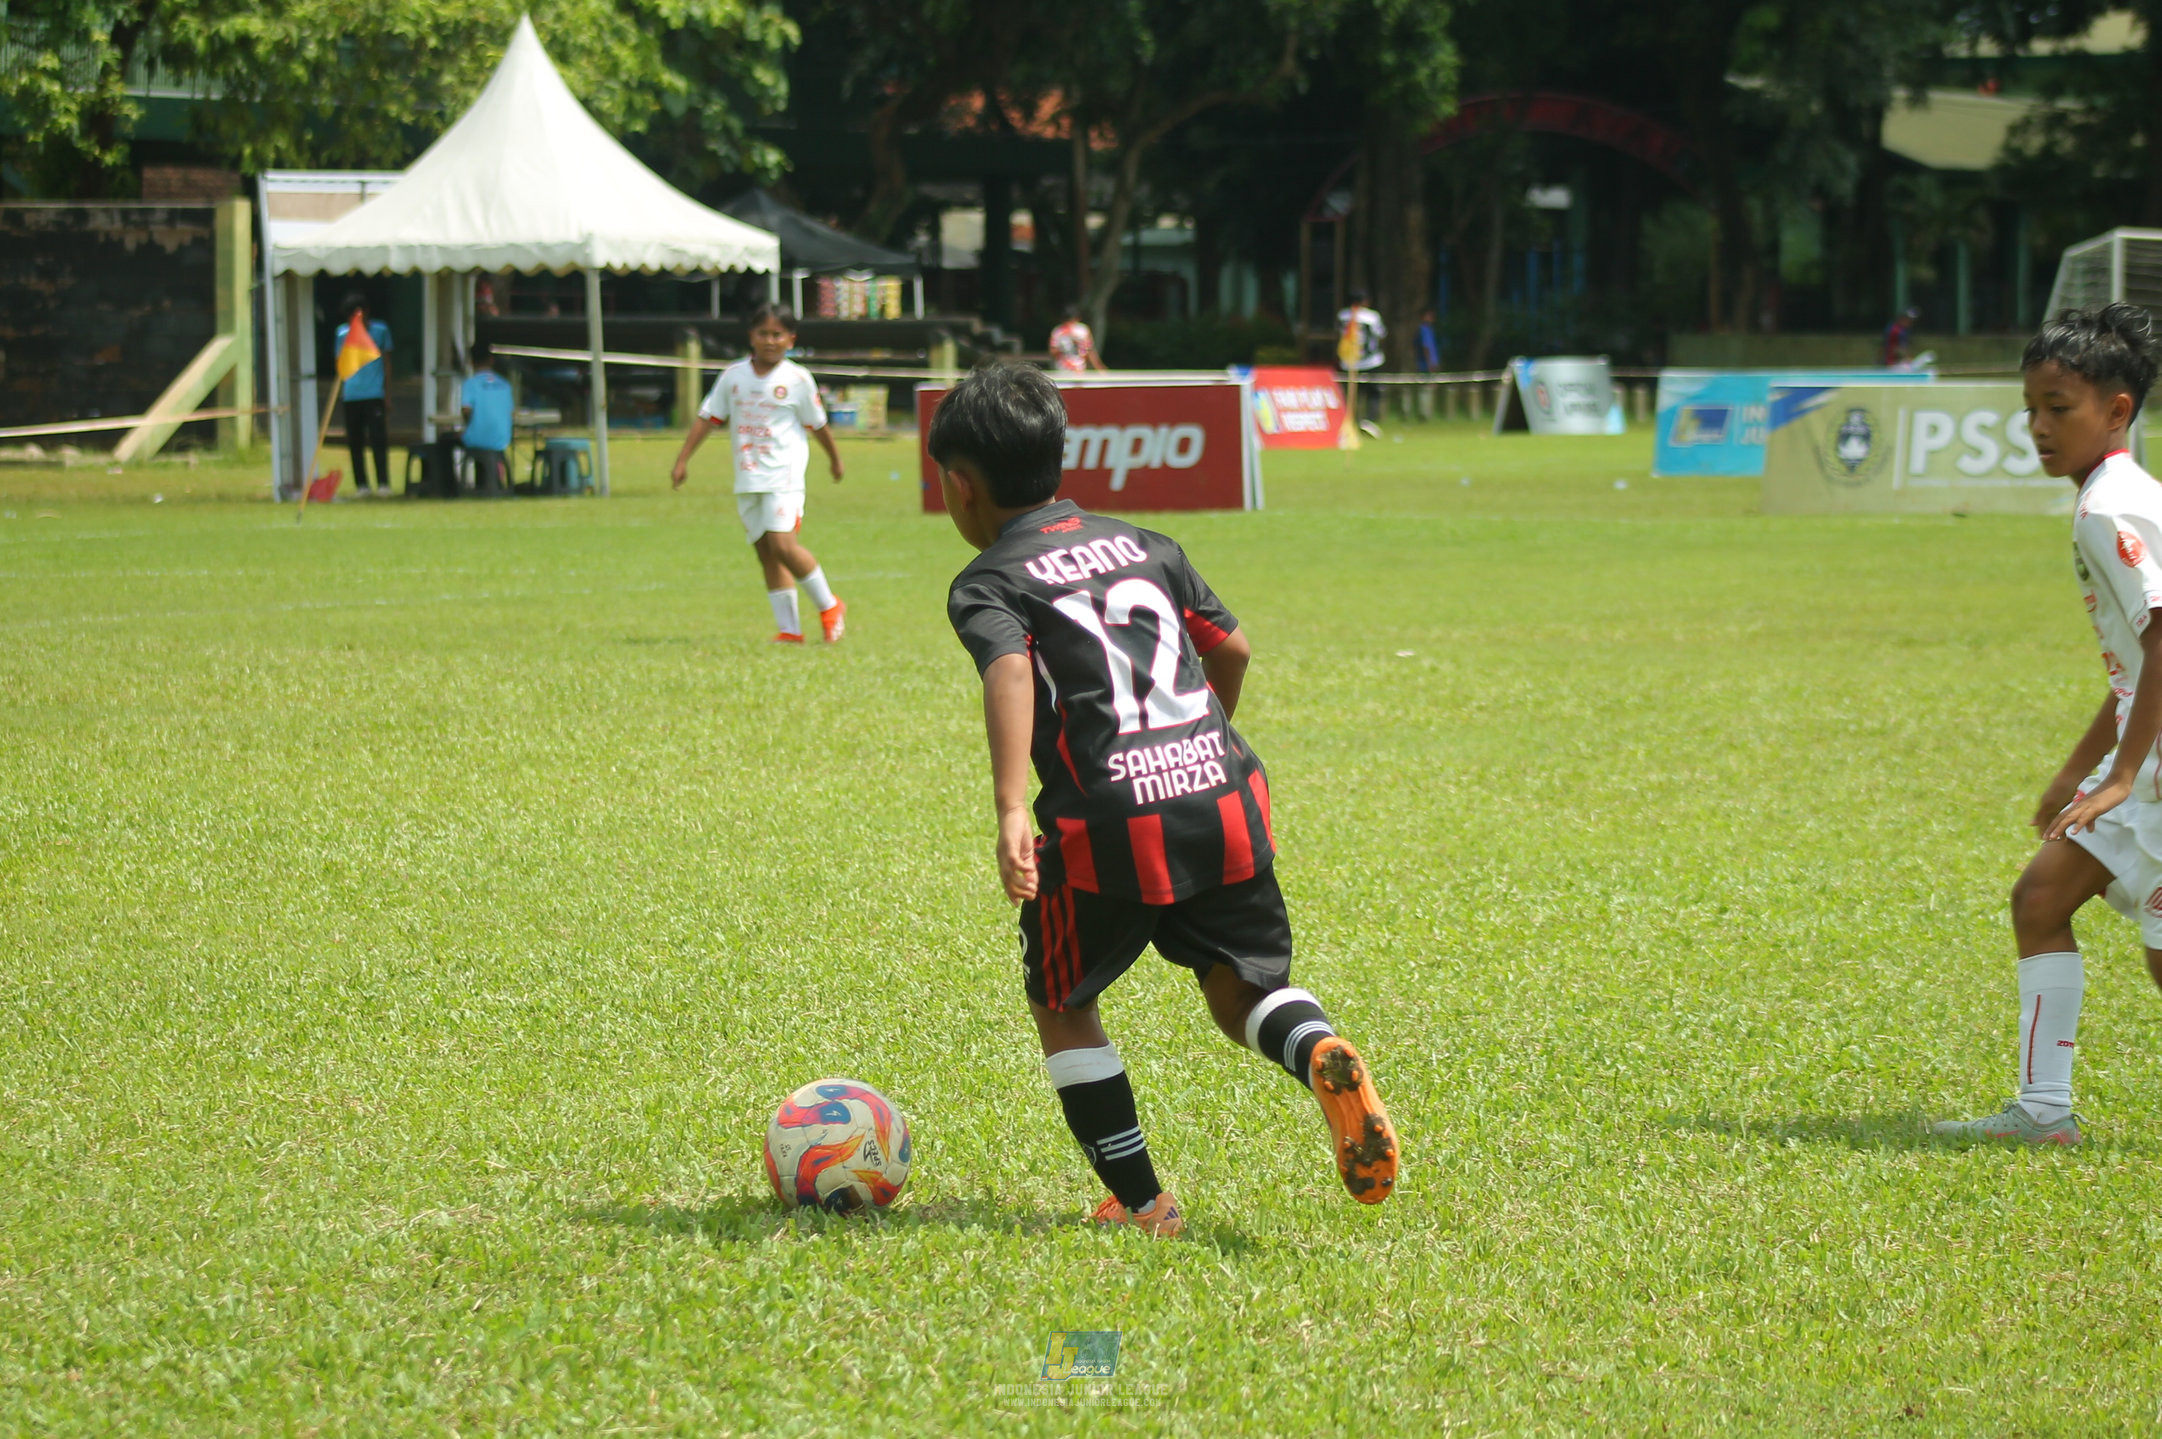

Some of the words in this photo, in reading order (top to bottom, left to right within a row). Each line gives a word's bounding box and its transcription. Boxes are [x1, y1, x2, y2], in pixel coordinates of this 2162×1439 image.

[1024, 535, 1148, 585] KEANO
[1052, 578, 1210, 735] 12
[1107, 731, 1226, 782] SAHABAT
[1132, 761, 1227, 805] MIRZA
